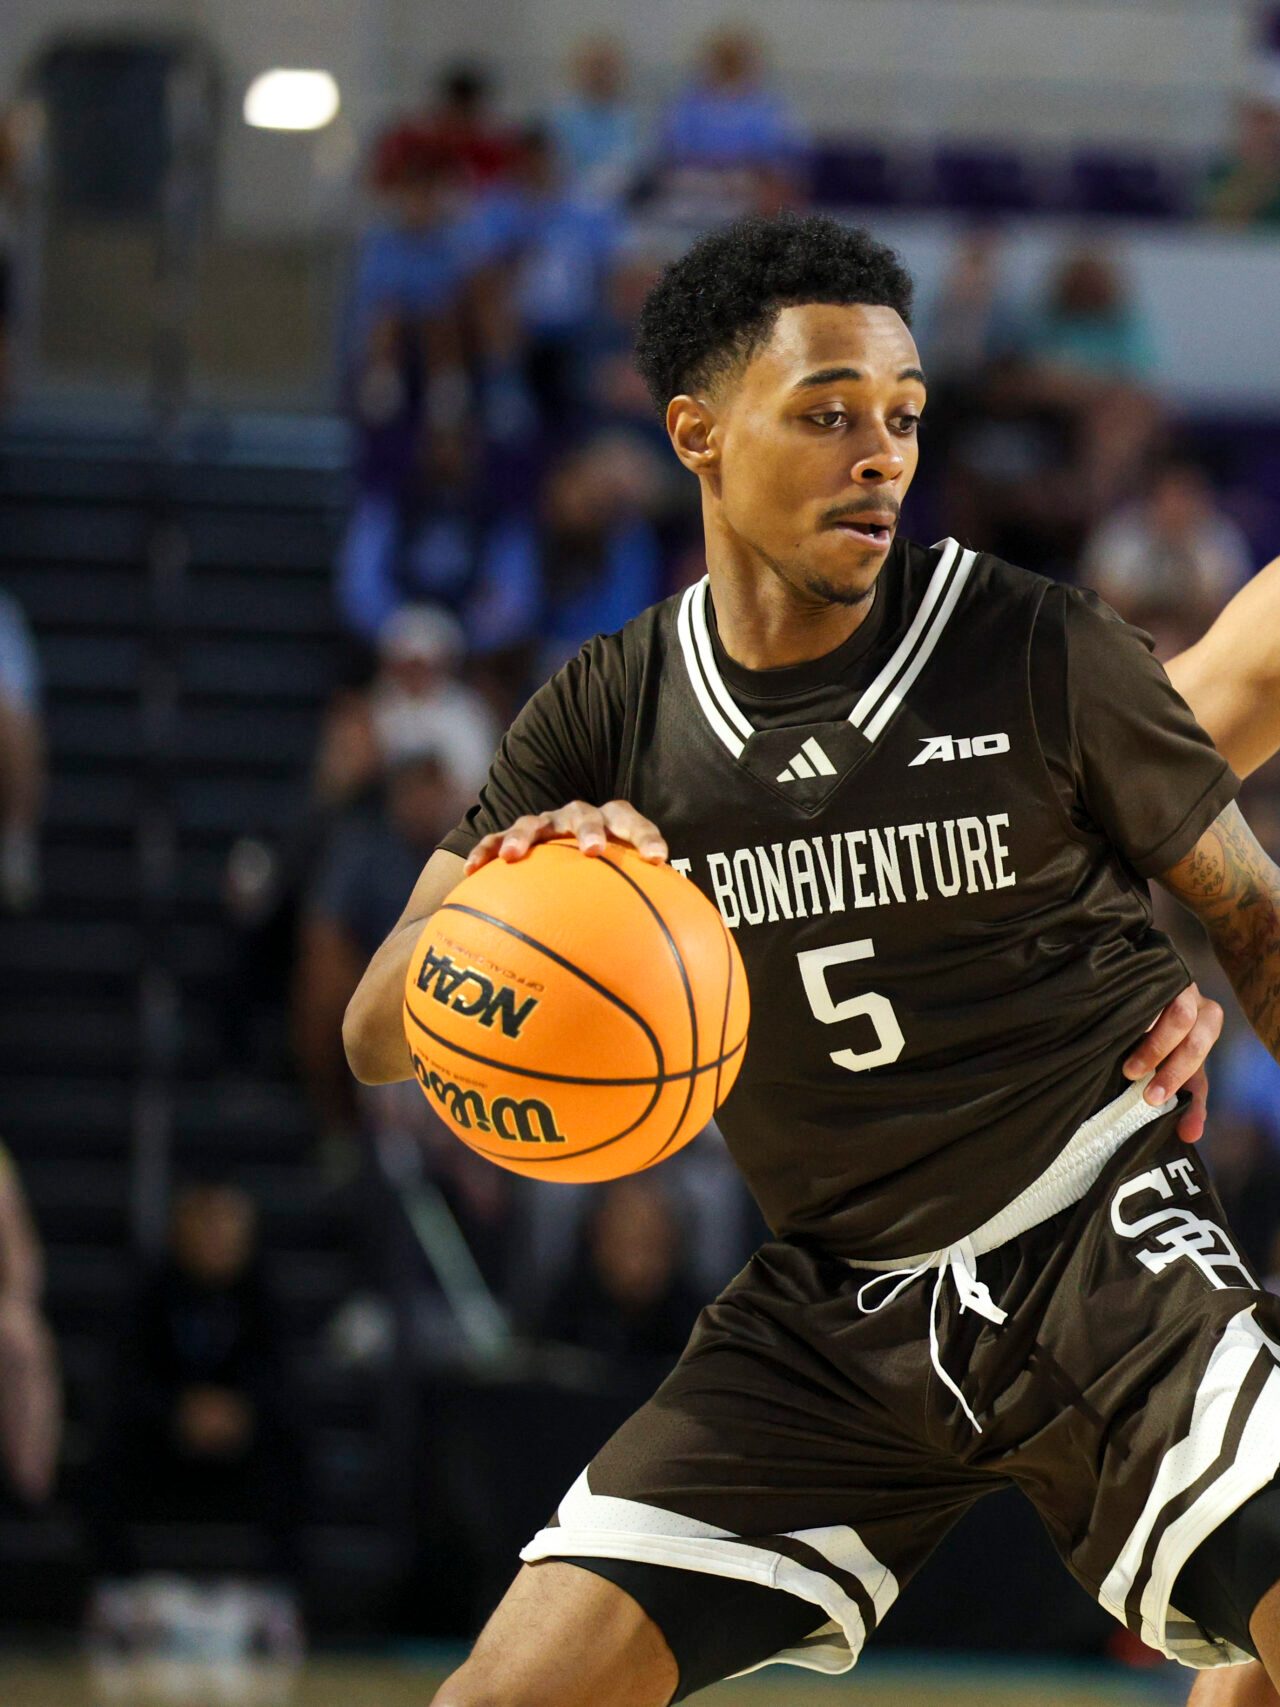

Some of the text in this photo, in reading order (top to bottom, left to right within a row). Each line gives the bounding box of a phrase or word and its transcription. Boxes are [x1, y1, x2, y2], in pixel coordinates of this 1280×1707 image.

[907, 732, 1011, 767] A10
[706, 813, 1017, 929] BONAVENTURE
[416, 945, 539, 1040] NCAA
[796, 938, 906, 1072] 5
[408, 1045, 566, 1143] Wilso
